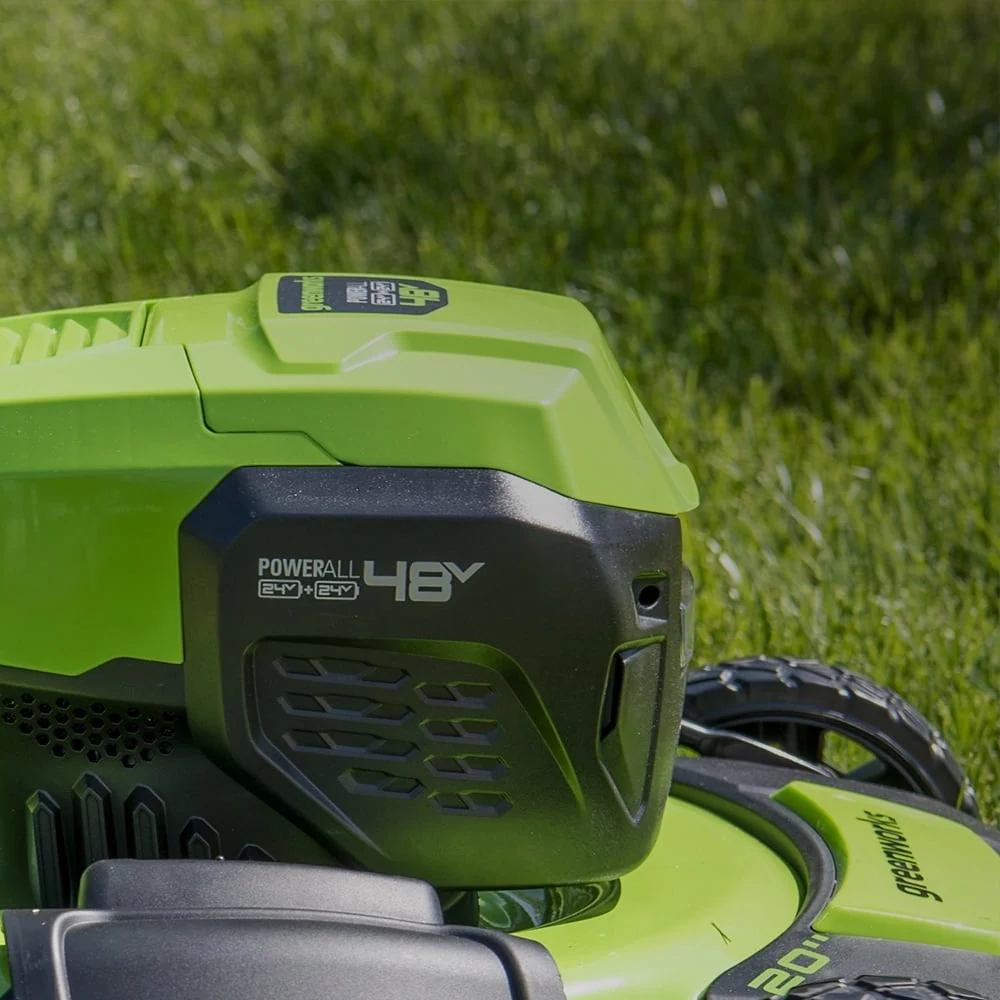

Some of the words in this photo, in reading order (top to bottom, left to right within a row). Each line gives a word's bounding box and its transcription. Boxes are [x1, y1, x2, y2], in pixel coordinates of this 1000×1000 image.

[258, 558, 360, 579] POWERALL
[363, 560, 485, 602] 48V
[856, 810, 944, 903] greenworks
